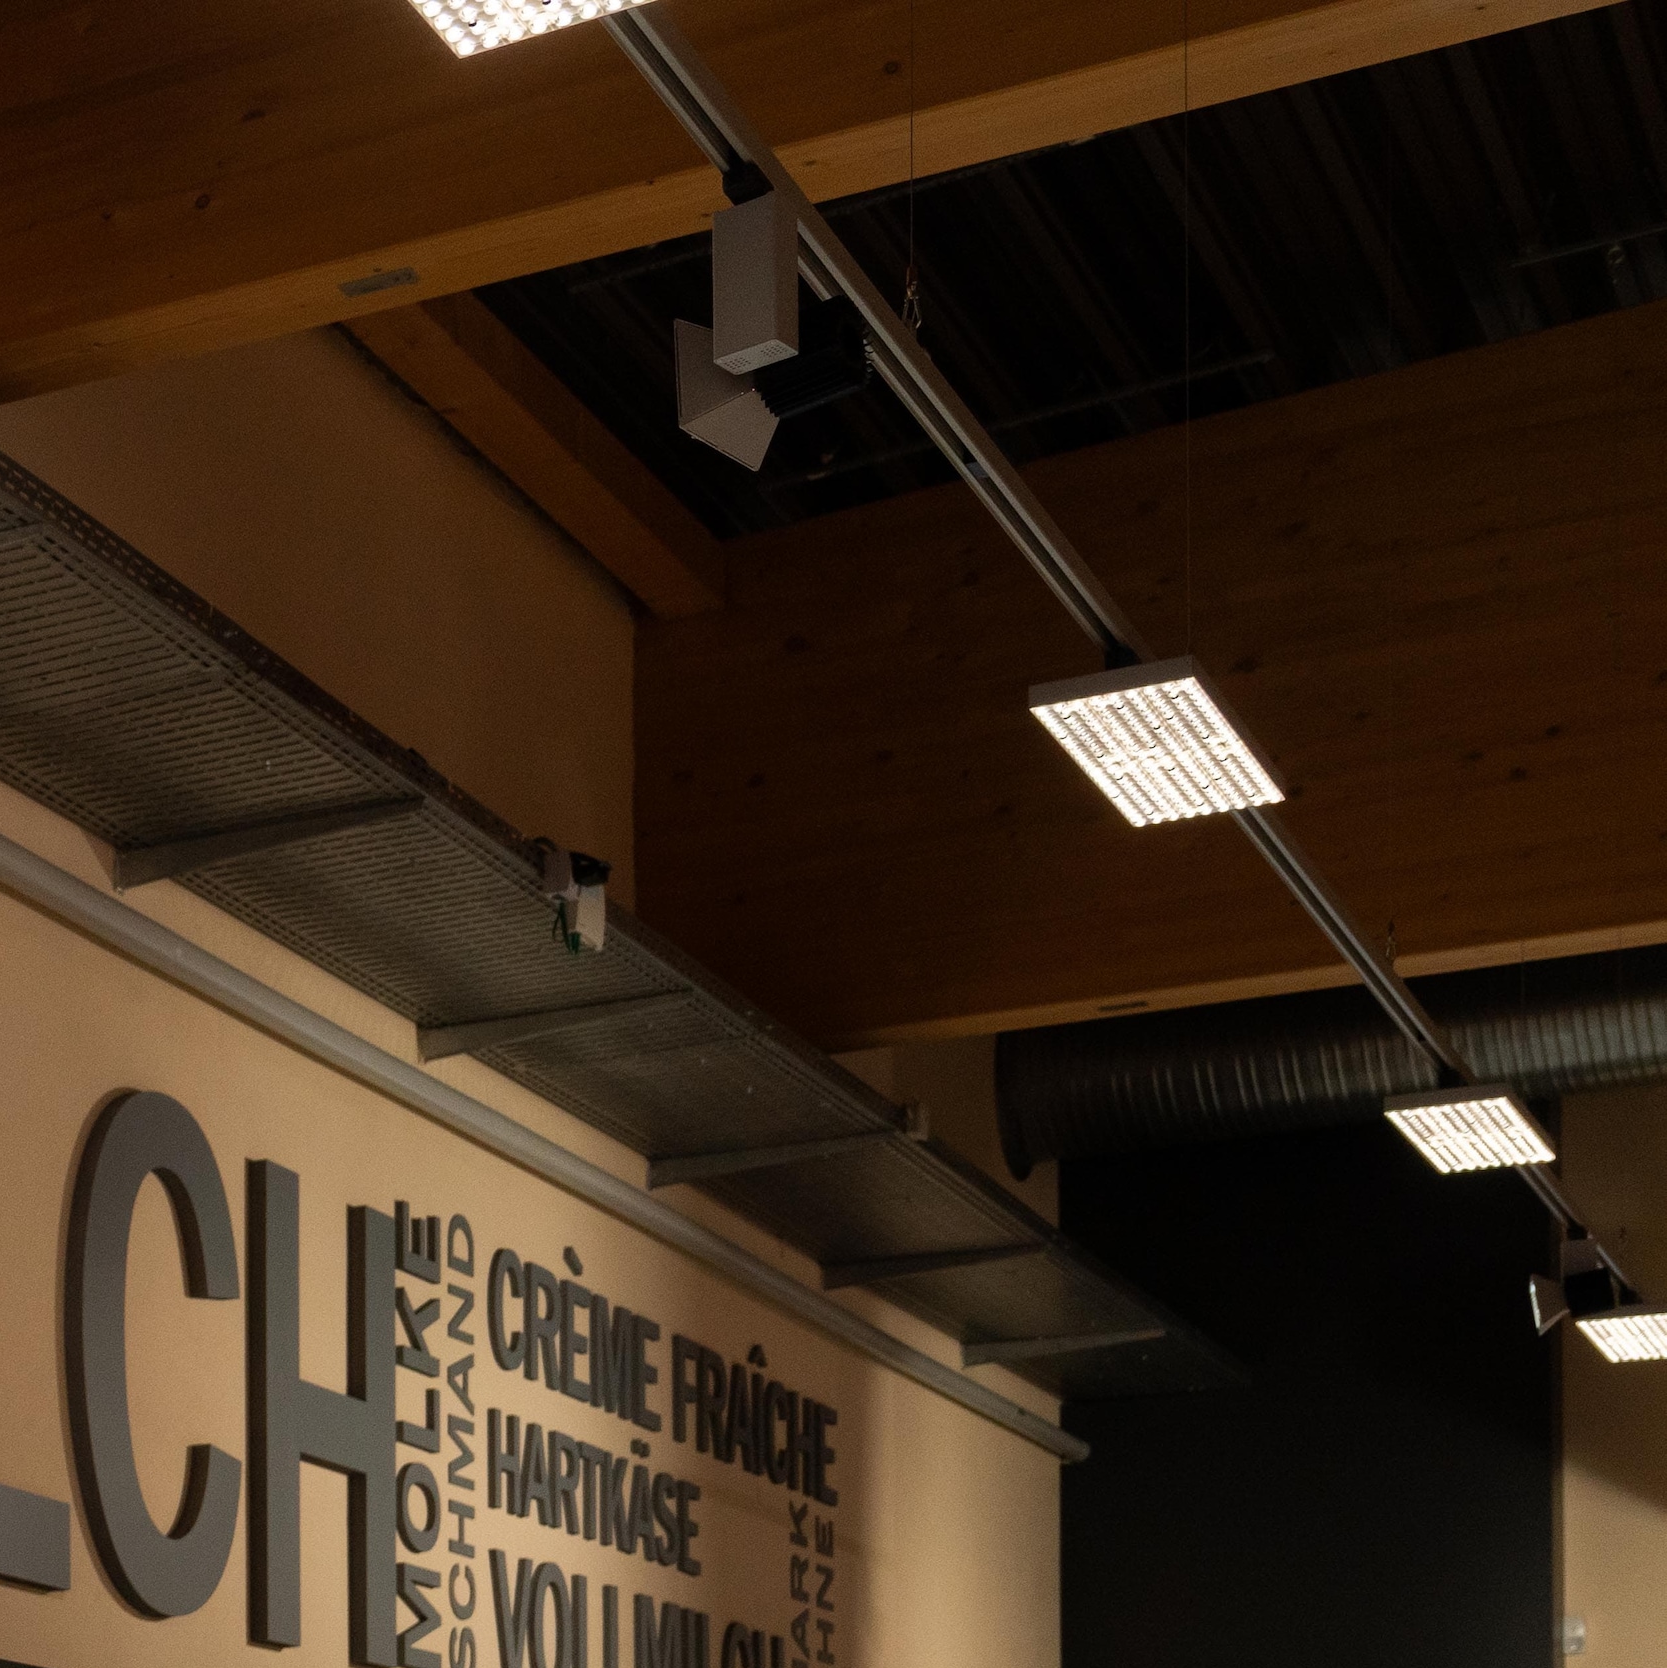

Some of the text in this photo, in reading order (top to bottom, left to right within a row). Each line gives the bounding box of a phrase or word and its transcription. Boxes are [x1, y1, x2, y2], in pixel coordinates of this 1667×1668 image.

[489, 1245, 838, 1508] CRÈME FRAÎCHE
[486, 1407, 700, 1575] HARTKÄSE
